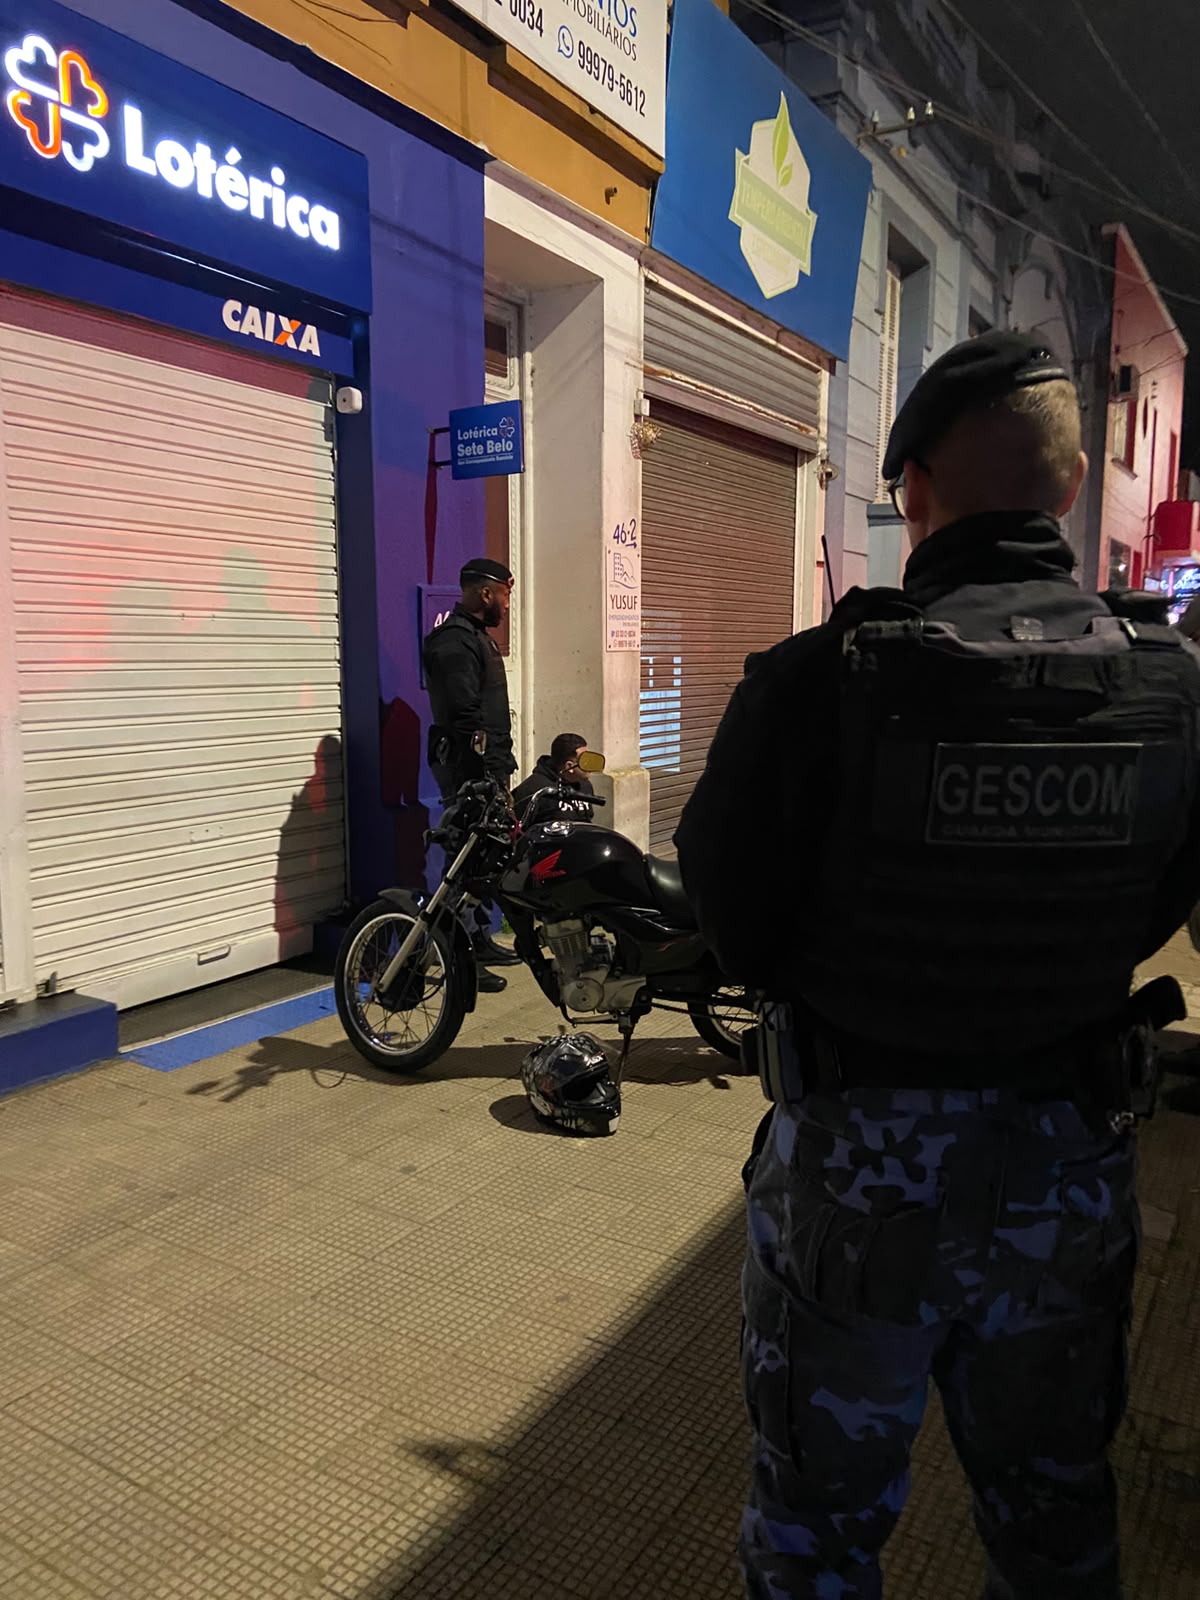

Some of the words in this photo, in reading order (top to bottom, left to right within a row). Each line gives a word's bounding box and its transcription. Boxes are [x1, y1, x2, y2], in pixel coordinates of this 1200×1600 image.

[578, 40, 647, 117] 99979-5612
[122, 104, 341, 251] Lotérica
[221, 298, 322, 358] CAIXA
[457, 425, 498, 441] Lotérica
[457, 442, 484, 457] Sete
[486, 438, 514, 454] Belo
[610, 594, 638, 611] YUSUF
[936, 762, 1137, 818] GESCOM
